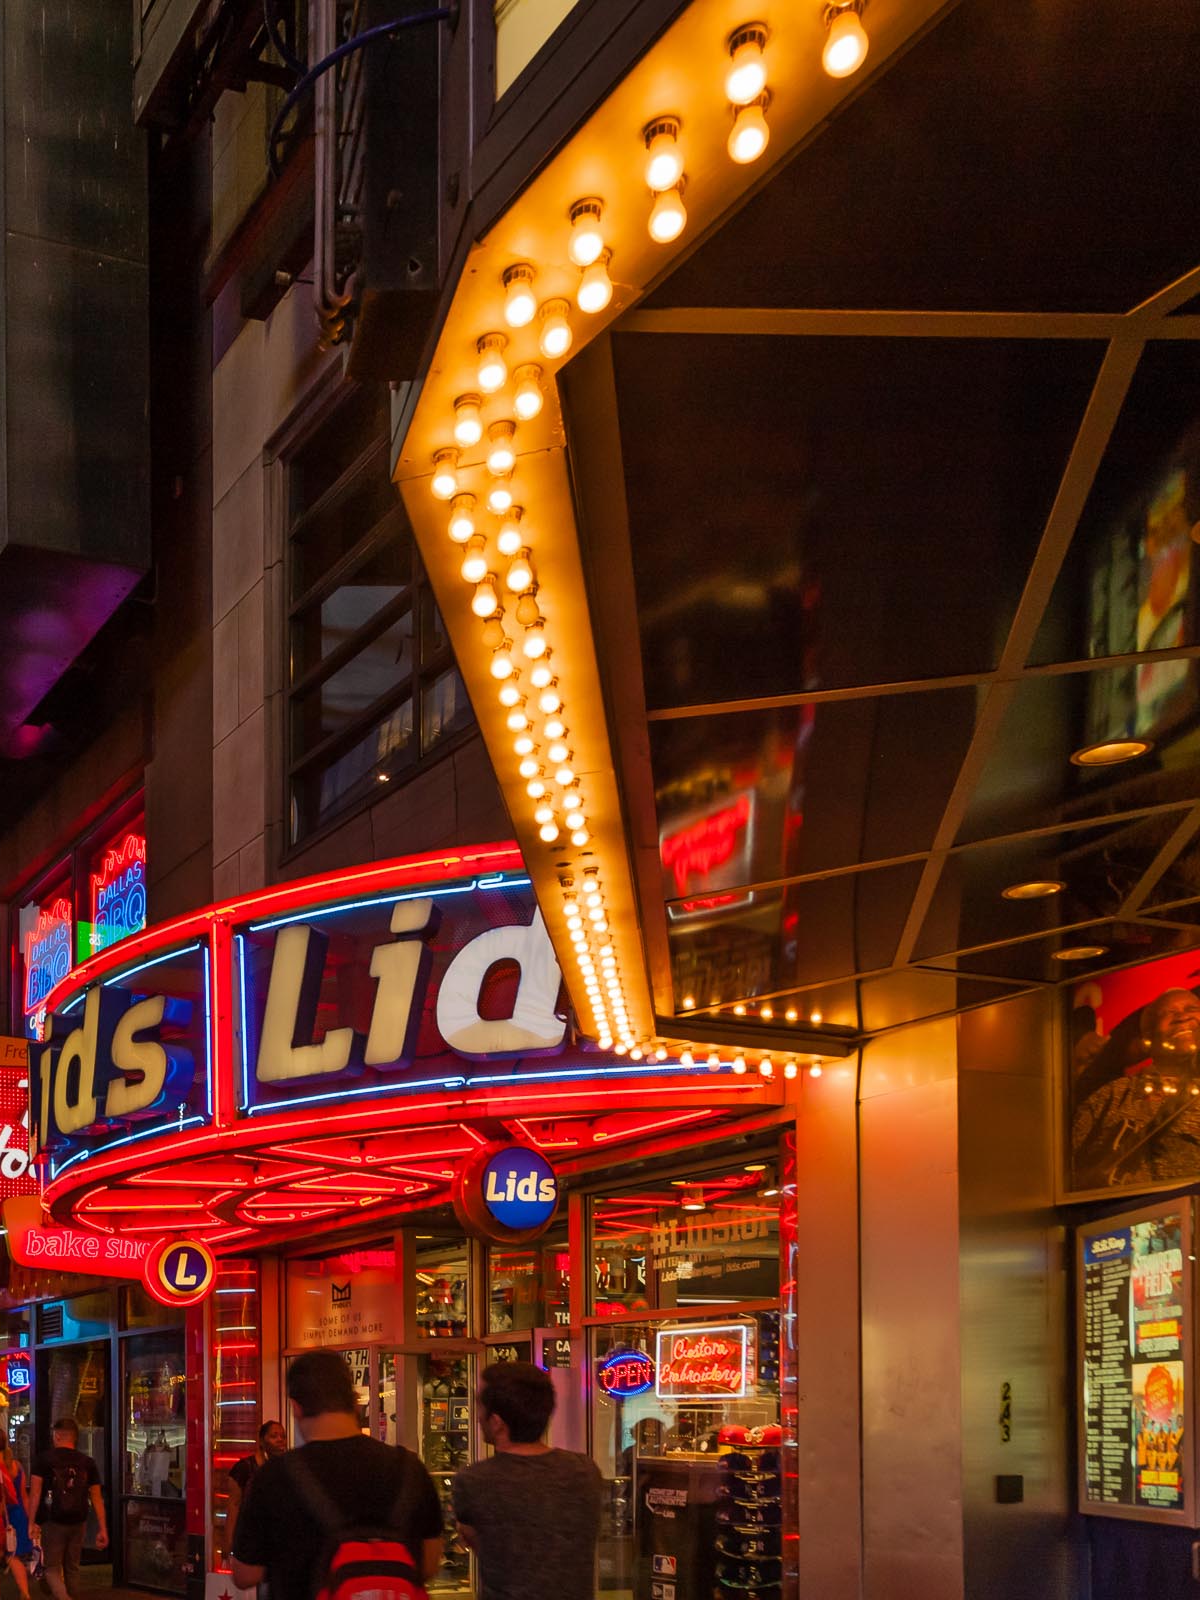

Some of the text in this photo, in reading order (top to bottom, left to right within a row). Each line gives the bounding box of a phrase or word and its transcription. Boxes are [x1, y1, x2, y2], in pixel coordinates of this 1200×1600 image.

[99, 861, 142, 910] DALLAS
[94, 882, 145, 952] BBQ
[33, 922, 67, 961] DALLAS
[28, 942, 69, 1008] BBQ
[40, 984, 166, 1147] ids
[487, 1171, 556, 1203] Lids
[26, 1229, 99, 1259] bake
[175, 1252, 197, 1285] L
[362, 1322, 383, 1333] MORE
[674, 1337, 728, 1359] Custom
[603, 1361, 649, 1389] OPEN
[660, 1363, 742, 1388] Embroidery
